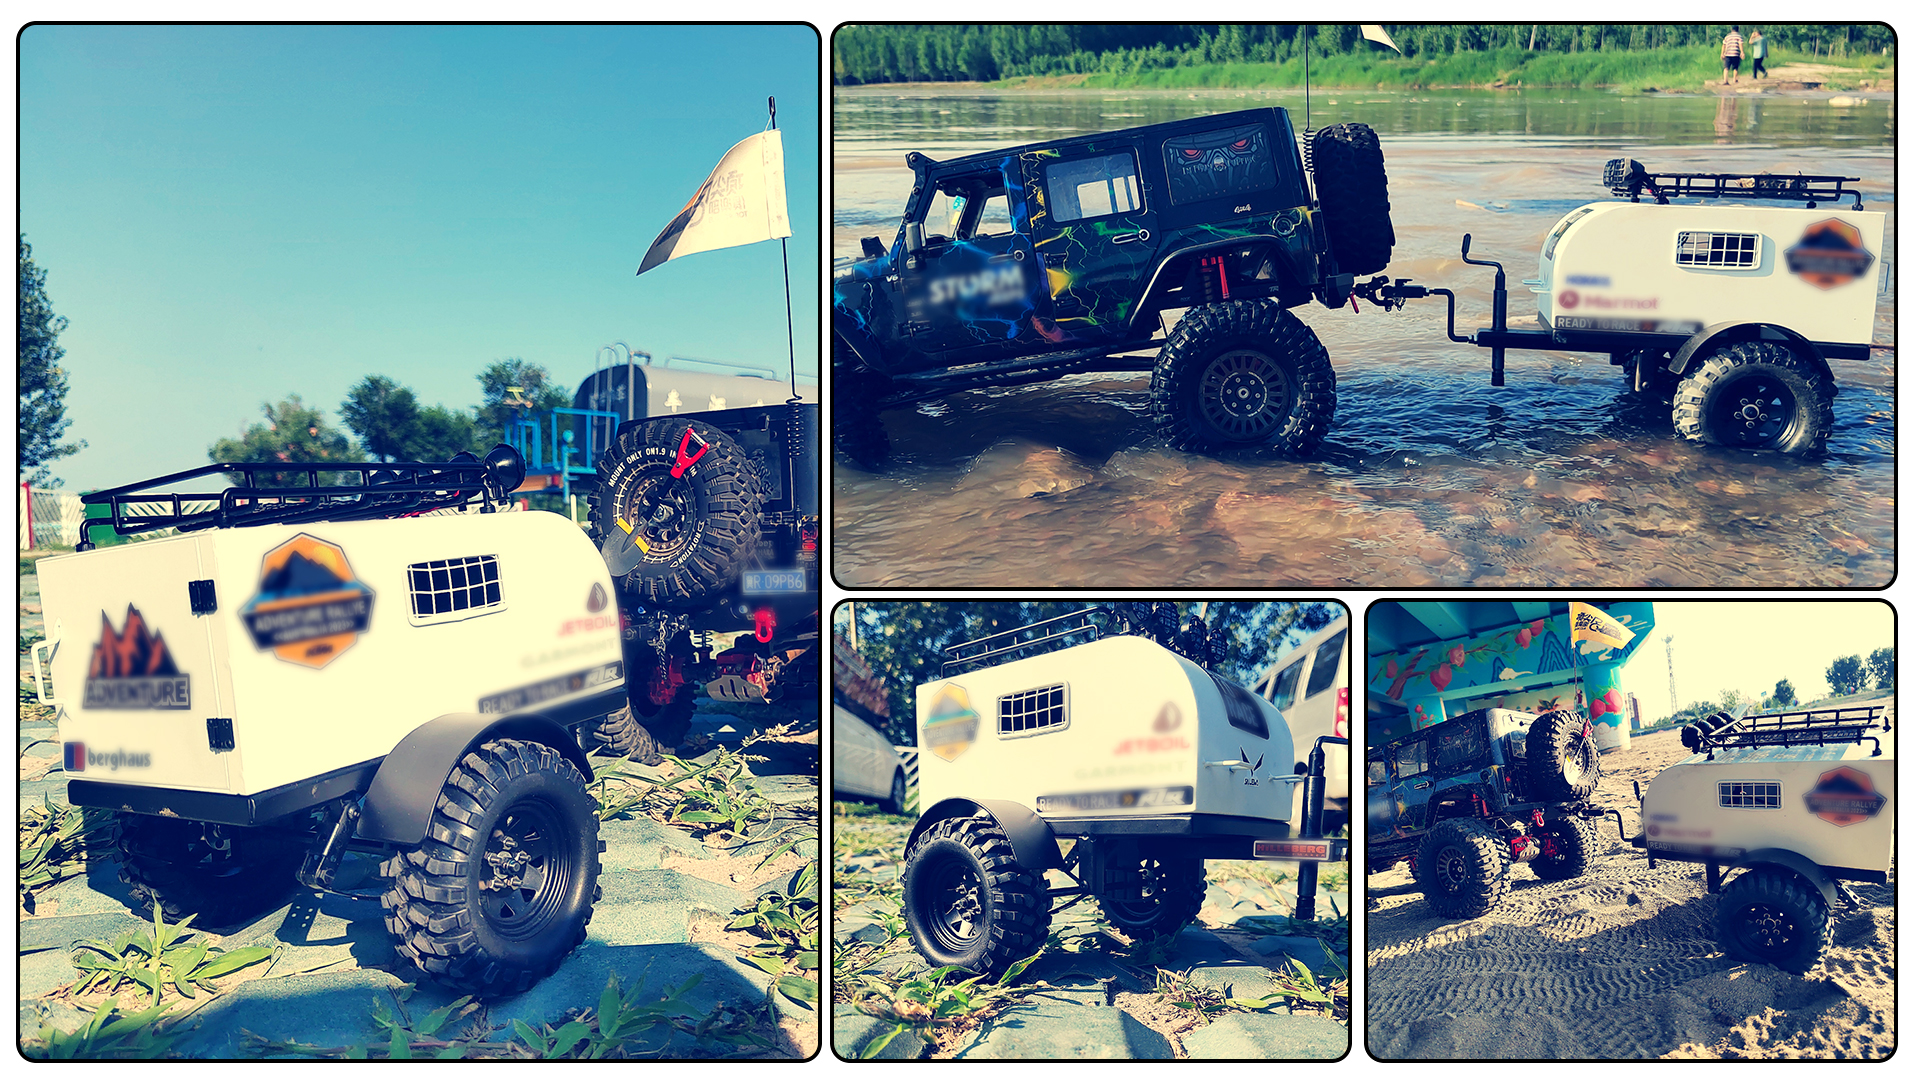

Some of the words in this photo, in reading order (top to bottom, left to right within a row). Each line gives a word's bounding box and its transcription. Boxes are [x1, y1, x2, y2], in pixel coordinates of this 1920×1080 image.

[886, 274, 898, 282] V6
[1557, 316, 1593, 328] READY
[1613, 319, 1641, 331] RACE
[608, 461, 626, 487] MOUNT
[626, 450, 643, 465] ONLY
[677, 531, 701, 564] ROTATION
[326, 600, 366, 620] RALLYE
[557, 614, 616, 637] JETBOIL
[86, 678, 188, 706] ADVENTURE
[483, 692, 522, 714] READY
[88, 747, 151, 771] berghaus
[1039, 795, 1072, 812] READY
[1850, 800, 1878, 809] RALLYE
[1649, 841, 1672, 850] READY
